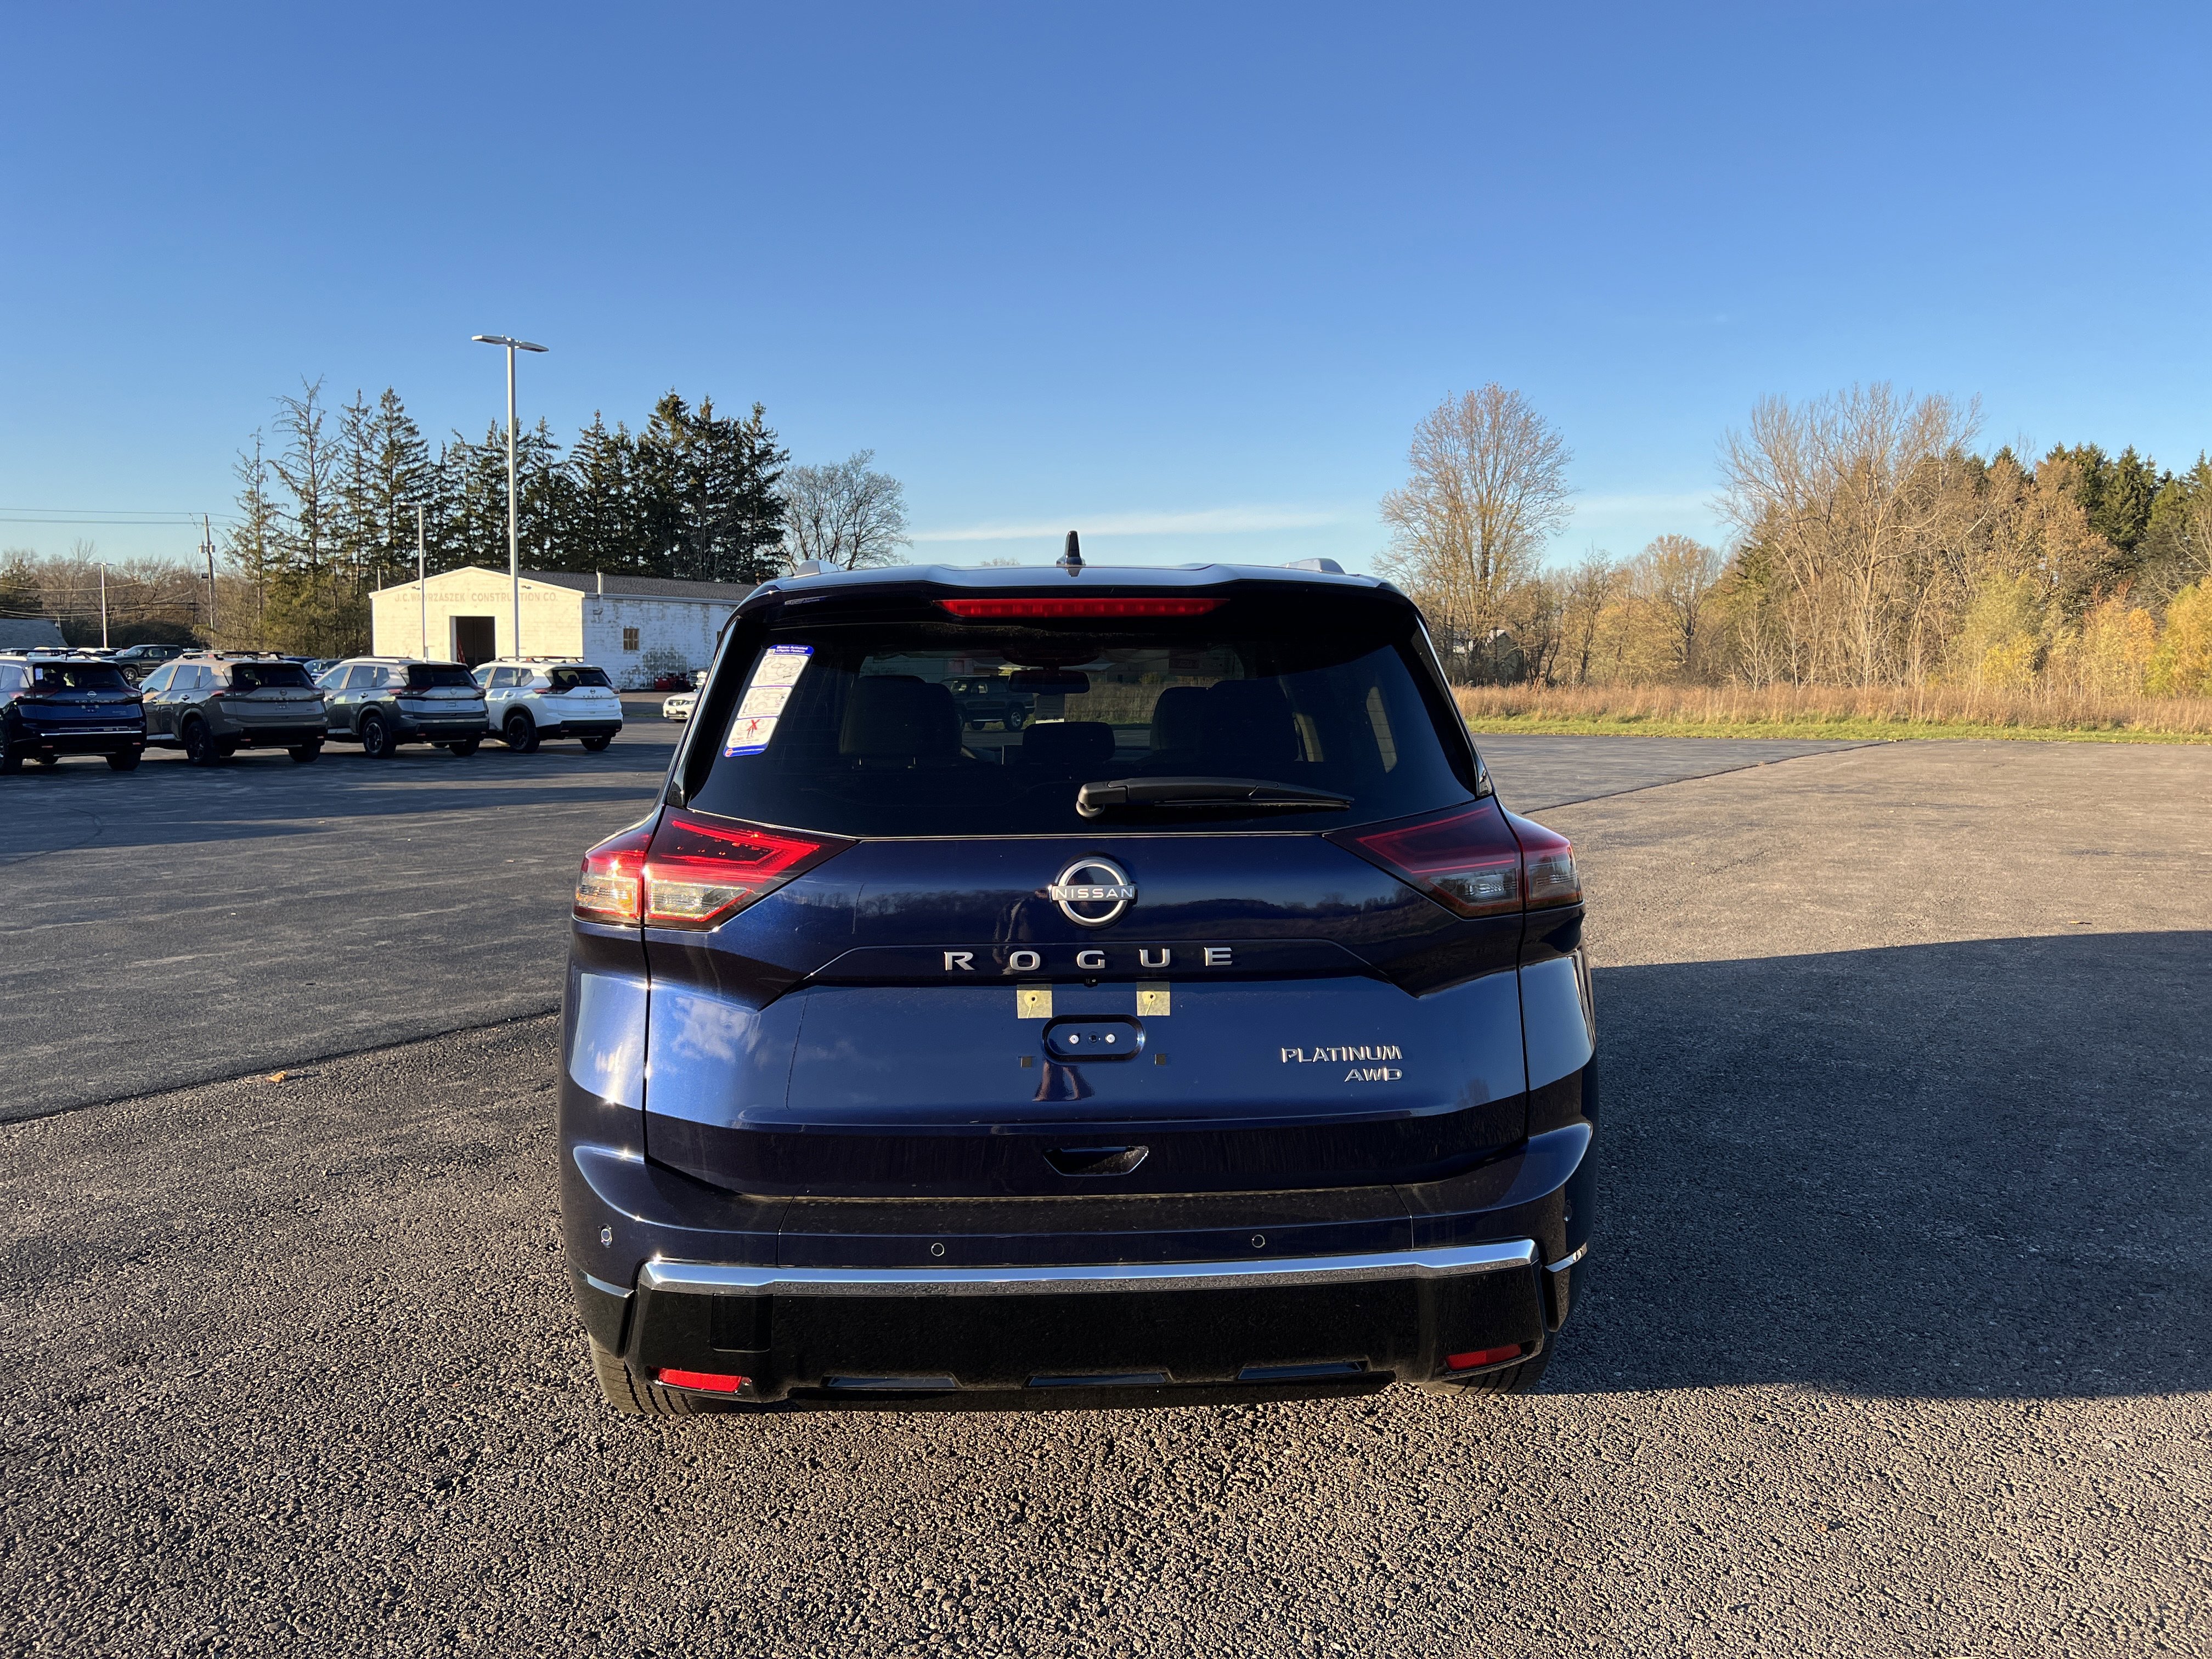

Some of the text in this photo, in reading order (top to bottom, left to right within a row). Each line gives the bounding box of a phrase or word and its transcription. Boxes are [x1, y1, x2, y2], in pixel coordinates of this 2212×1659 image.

[471, 592, 540, 602] CONSTRUTION
[543, 592, 558, 602] CO.
[1054, 888, 1133, 899] NISSAN
[944, 947, 1233, 971] ROGUE
[1281, 1045, 1403, 1063] PLATINUM
[1344, 1067, 1403, 1082] AWD
